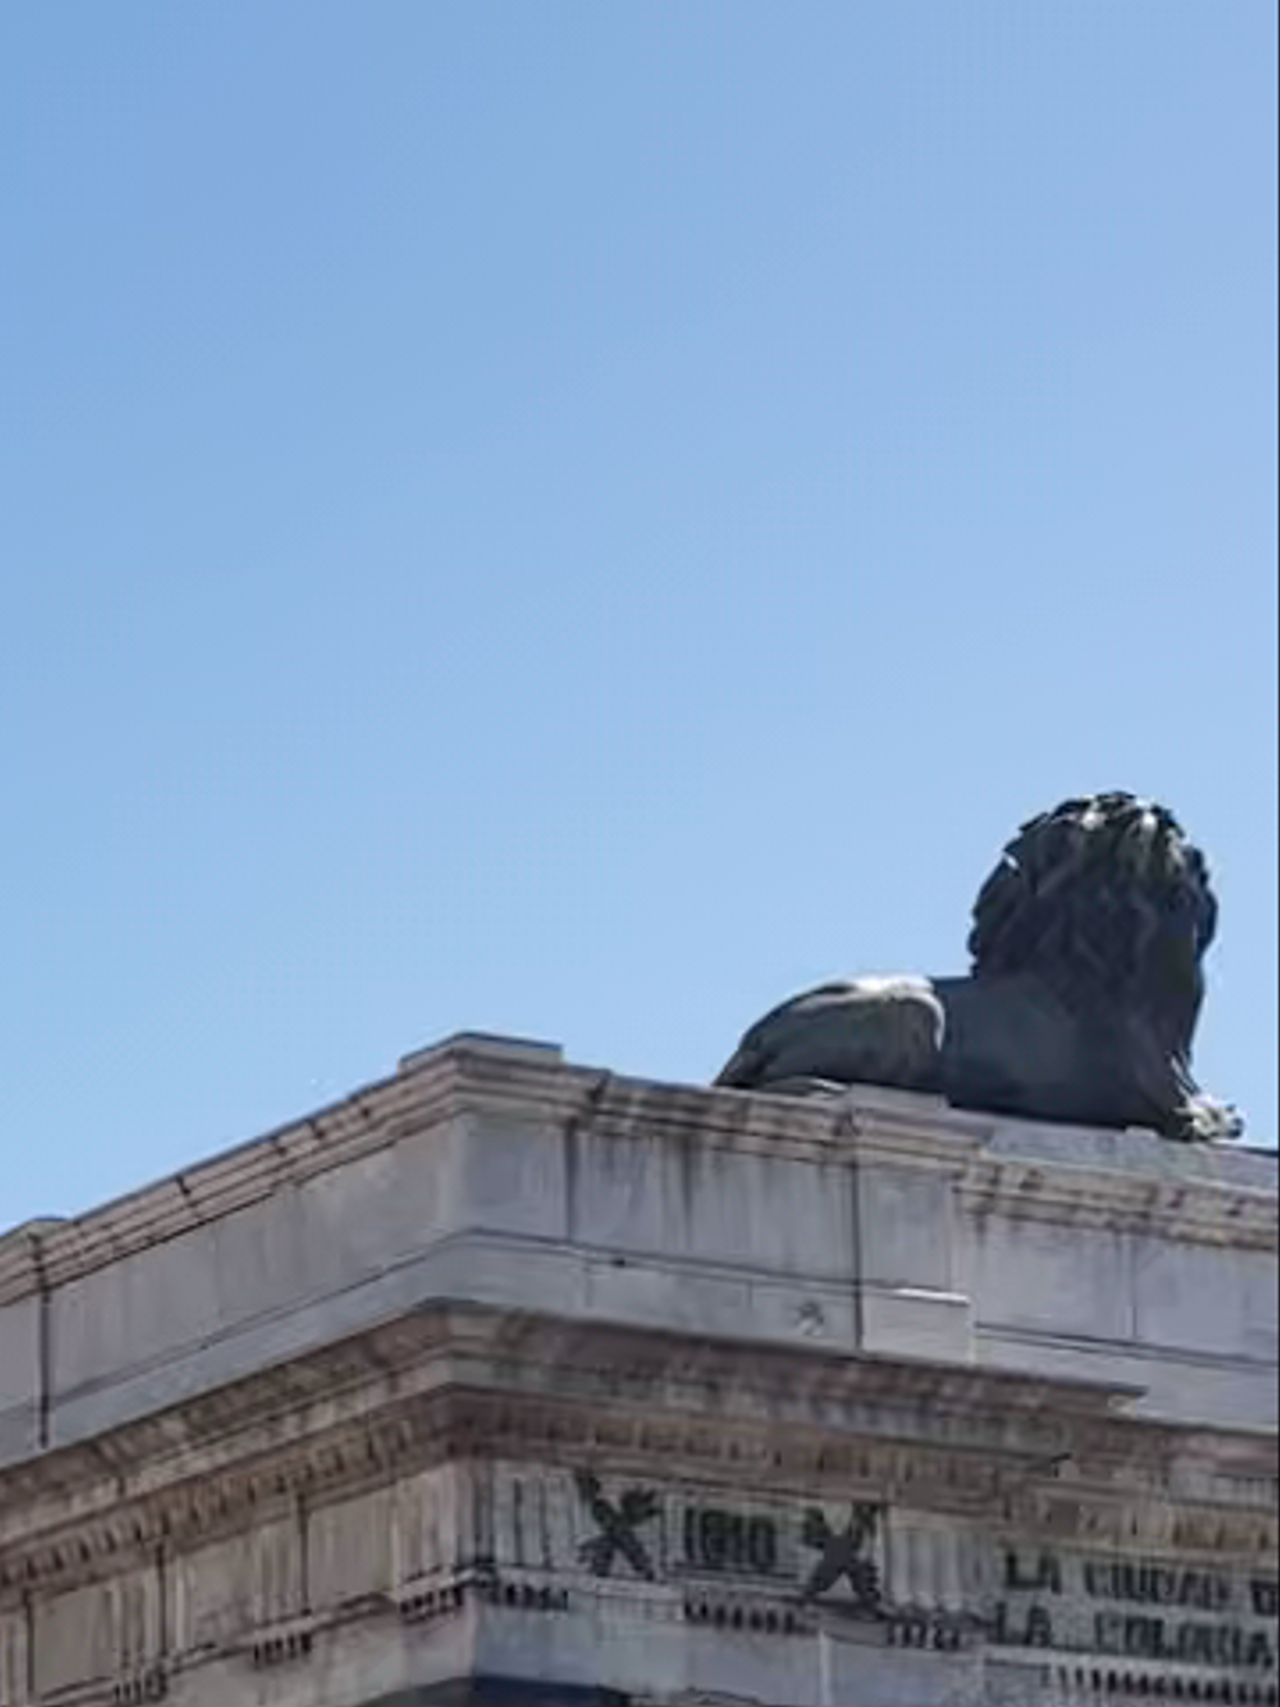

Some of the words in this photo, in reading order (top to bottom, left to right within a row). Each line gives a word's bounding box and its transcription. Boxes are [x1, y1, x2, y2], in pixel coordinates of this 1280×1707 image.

[1004, 1550, 1063, 1594] LA
[1081, 1561, 1231, 1612] CIUDAD
[986, 1600, 1052, 1647] LA
[1092, 1611, 1275, 1669] COLONIA
